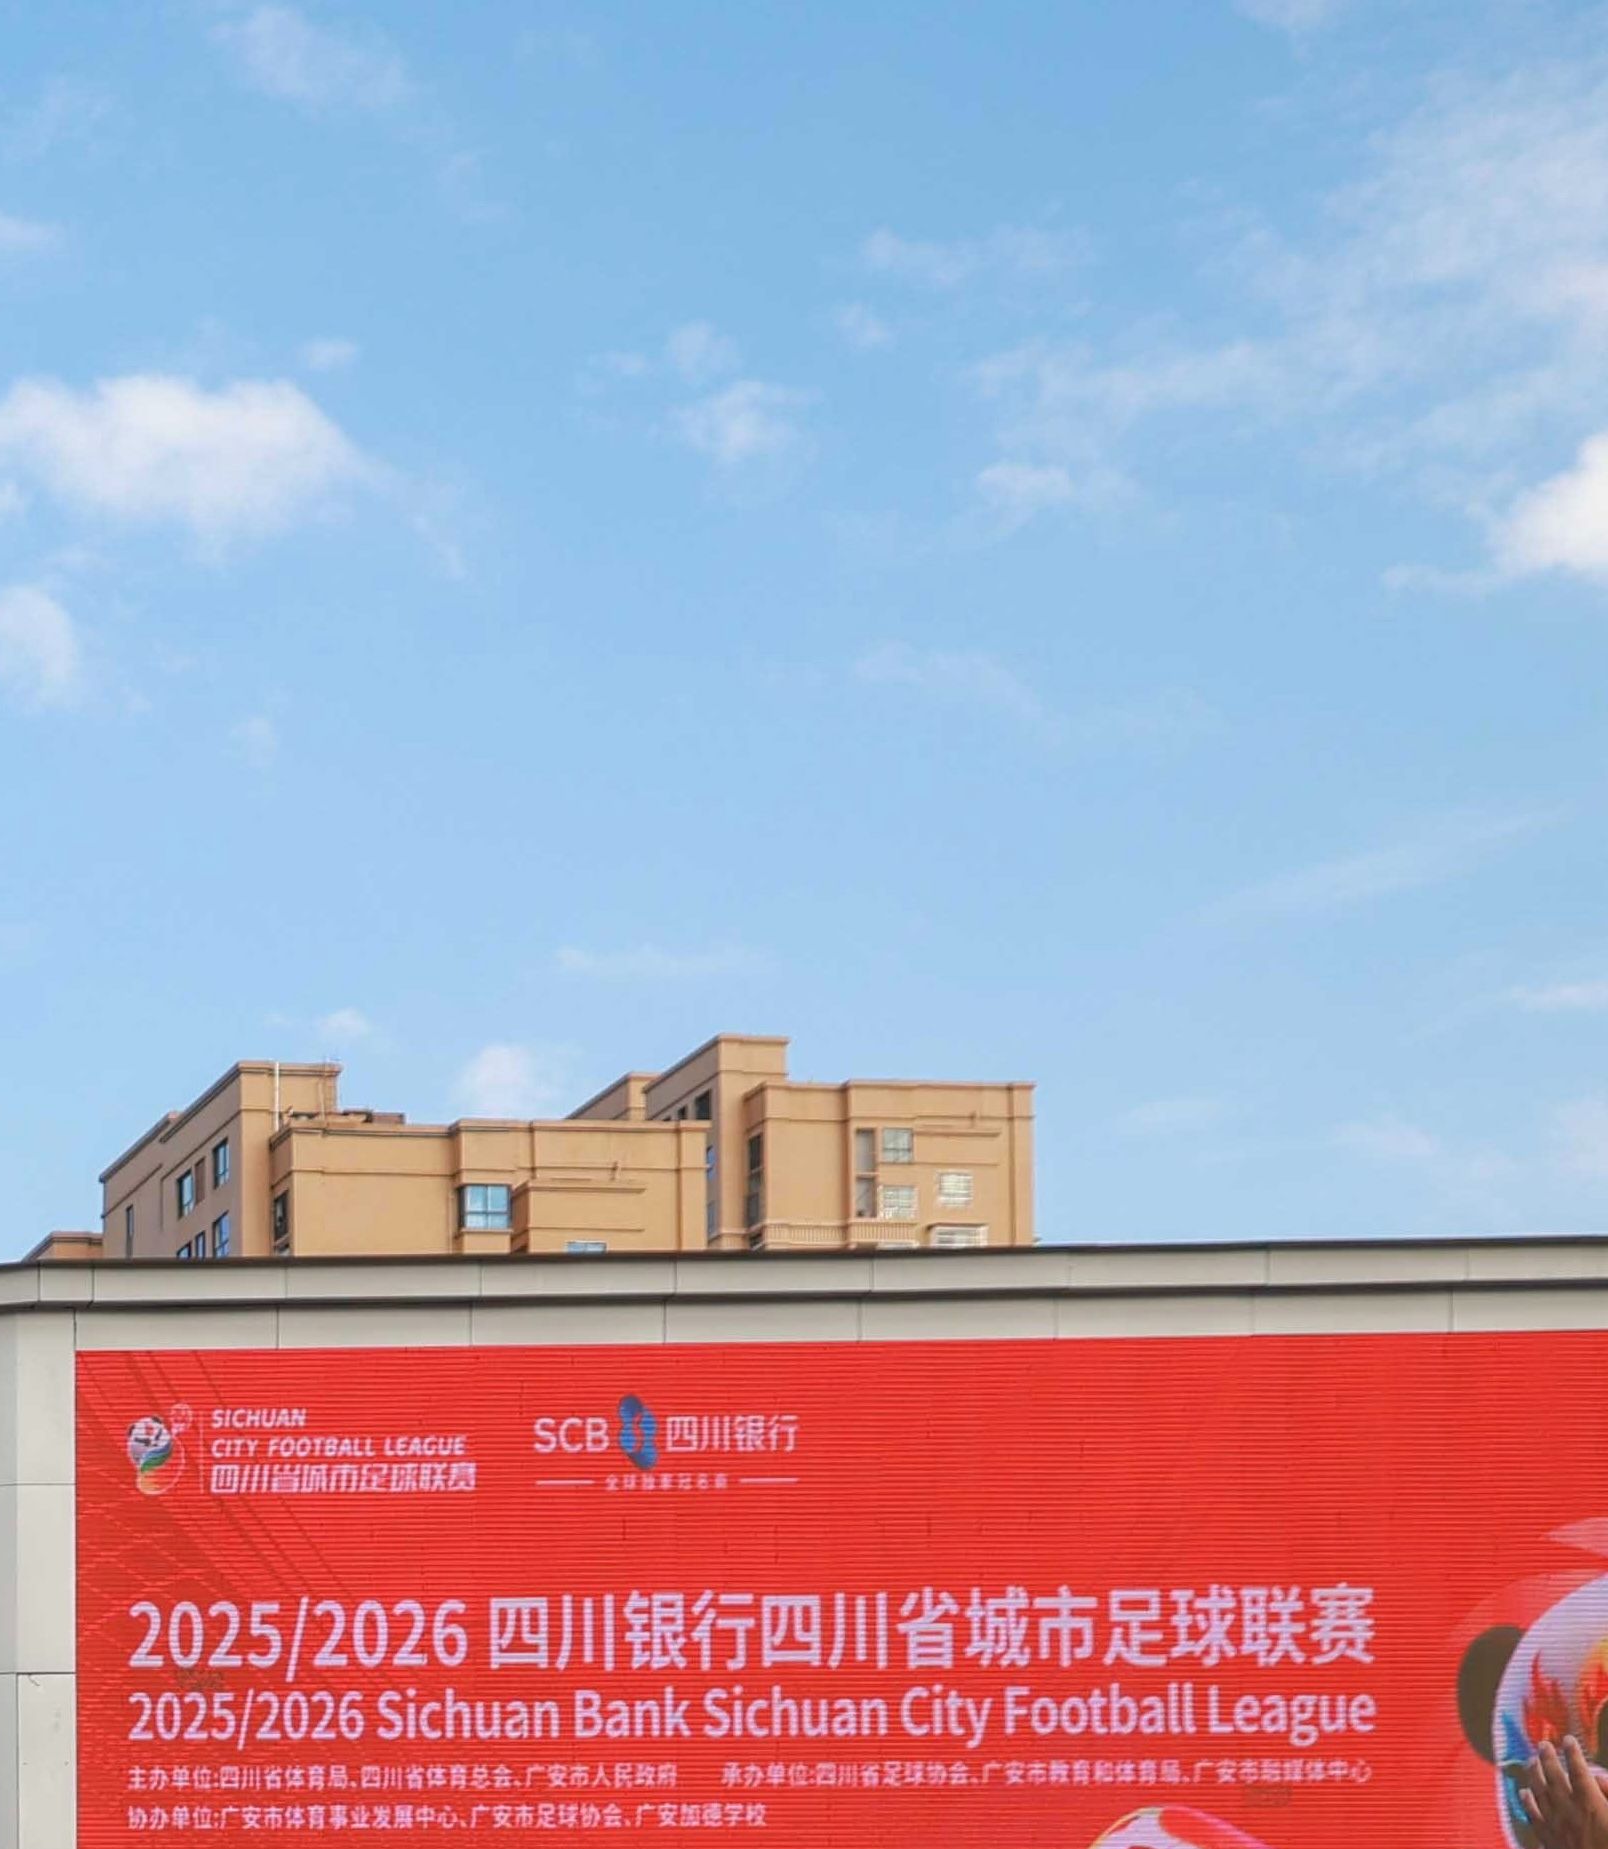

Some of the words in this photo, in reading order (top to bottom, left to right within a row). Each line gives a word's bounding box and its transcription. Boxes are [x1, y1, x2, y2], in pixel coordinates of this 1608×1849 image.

[211, 1408, 307, 1429] SICHUAN
[533, 1416, 610, 1453] SCB
[666, 1414, 800, 1453] 四川银行
[211, 1438, 257, 1459] CITY
[267, 1437, 376, 1458] FOOTBALL
[383, 1435, 468, 1457] LEAGUE
[210, 1463, 477, 1494] 四川省城市足球联赛
[127, 1600, 467, 1682] 2025/2026
[489, 1583, 1375, 1673] 四川银行四川省城市足球联赛
[127, 1691, 365, 1750] 2025/2026
[375, 1687, 560, 1742] Sichuan
[573, 1685, 691, 1740] Bank
[703, 1684, 888, 1740] Sichuan
[898, 1684, 992, 1750] City
[1004, 1681, 1197, 1738] Football
[1209, 1684, 1376, 1748] League
